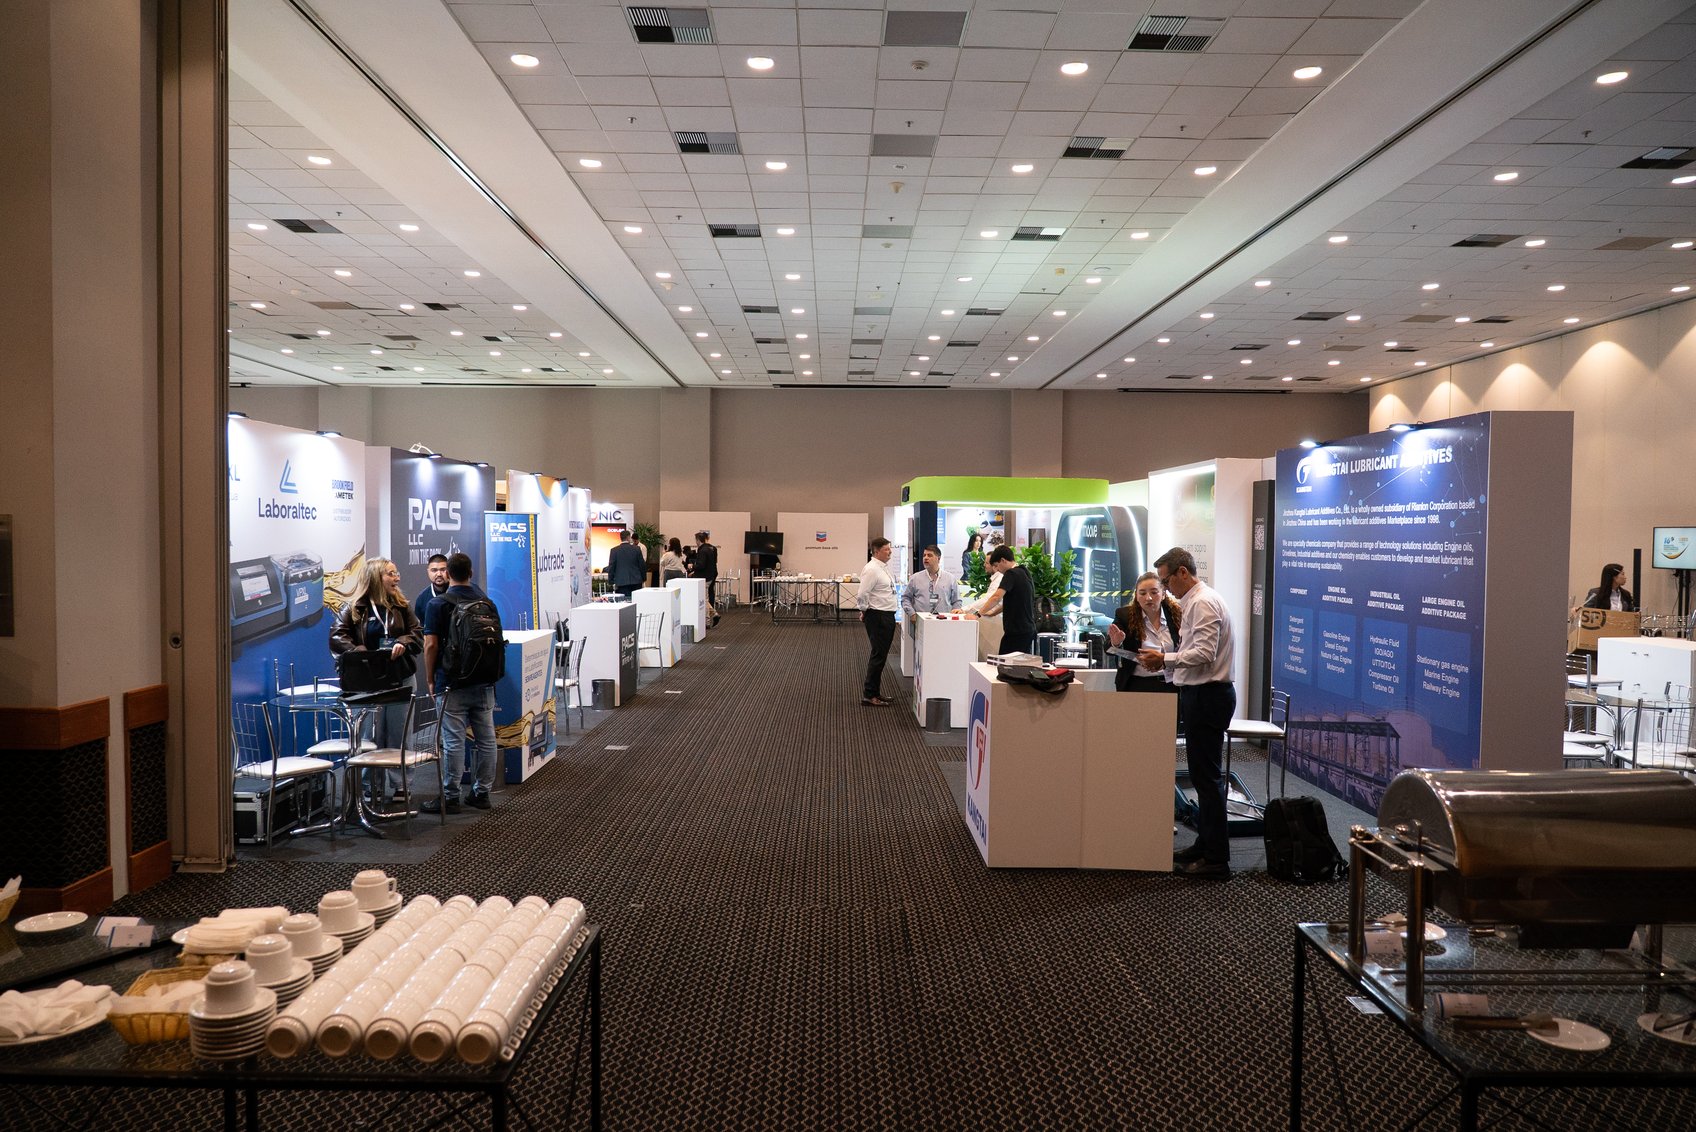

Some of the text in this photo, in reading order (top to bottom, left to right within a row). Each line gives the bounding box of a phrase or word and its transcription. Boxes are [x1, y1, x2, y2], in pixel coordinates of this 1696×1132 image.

[1350, 454, 1398, 474] LUBRICANT
[258, 497, 317, 521] Laboraltec
[1358, 505, 1370, 514] wholly
[1371, 504, 1383, 512] owned
[1384, 503, 1405, 513] subsidiary
[1406, 502, 1410, 511] of
[1429, 501, 1458, 512] Corporation
[1459, 499, 1475, 509] based
[408, 498, 461, 531] PACS
[1369, 516, 1386, 525] additives
[1387, 515, 1413, 526] Marketplace
[1414, 515, 1426, 524] since
[490, 522, 526, 532] PACS
[408, 533, 424, 546] LLC
[1344, 540, 1359, 549] provides
[1363, 542, 1374, 550] range
[1379, 540, 1401, 551] technology
[1402, 541, 1422, 550] solutions
[1423, 541, 1443, 552] including
[1444, 542, 1461, 553] Engine
[1463, 542, 1474, 553] oils,
[409, 549, 420, 565] JOIN
[1338, 552, 1354, 561] chemistry
[1371, 553, 1391, 561] customers
[1397, 554, 1413, 564] develop
[1414, 554, 1423, 563] and
[1424, 555, 1440, 564] market
[1441, 556, 1462, 565] lubricant
[1463, 556, 1473, 565] that
[1370, 590, 1393, 599] INDUSTRIAL
[1367, 600, 1404, 612] ADDITIVE PACKAGE
[1422, 596, 1437, 604] LARGE
[1438, 598, 1456, 607] ENGINE
[1421, 607, 1466, 620] ADDITIVE PACKAGE
[622, 632, 634, 652] PACS
[1370, 635, 1400, 648] Hydraulic Fluid
[1416, 654, 1468, 673] Stationary gas engine
[1368, 669, 1392, 680] Compressor
[1424, 669, 1459, 685] Marine Engine
[1372, 682, 1387, 693] Turbine
[1423, 682, 1460, 698] Railway Engine
